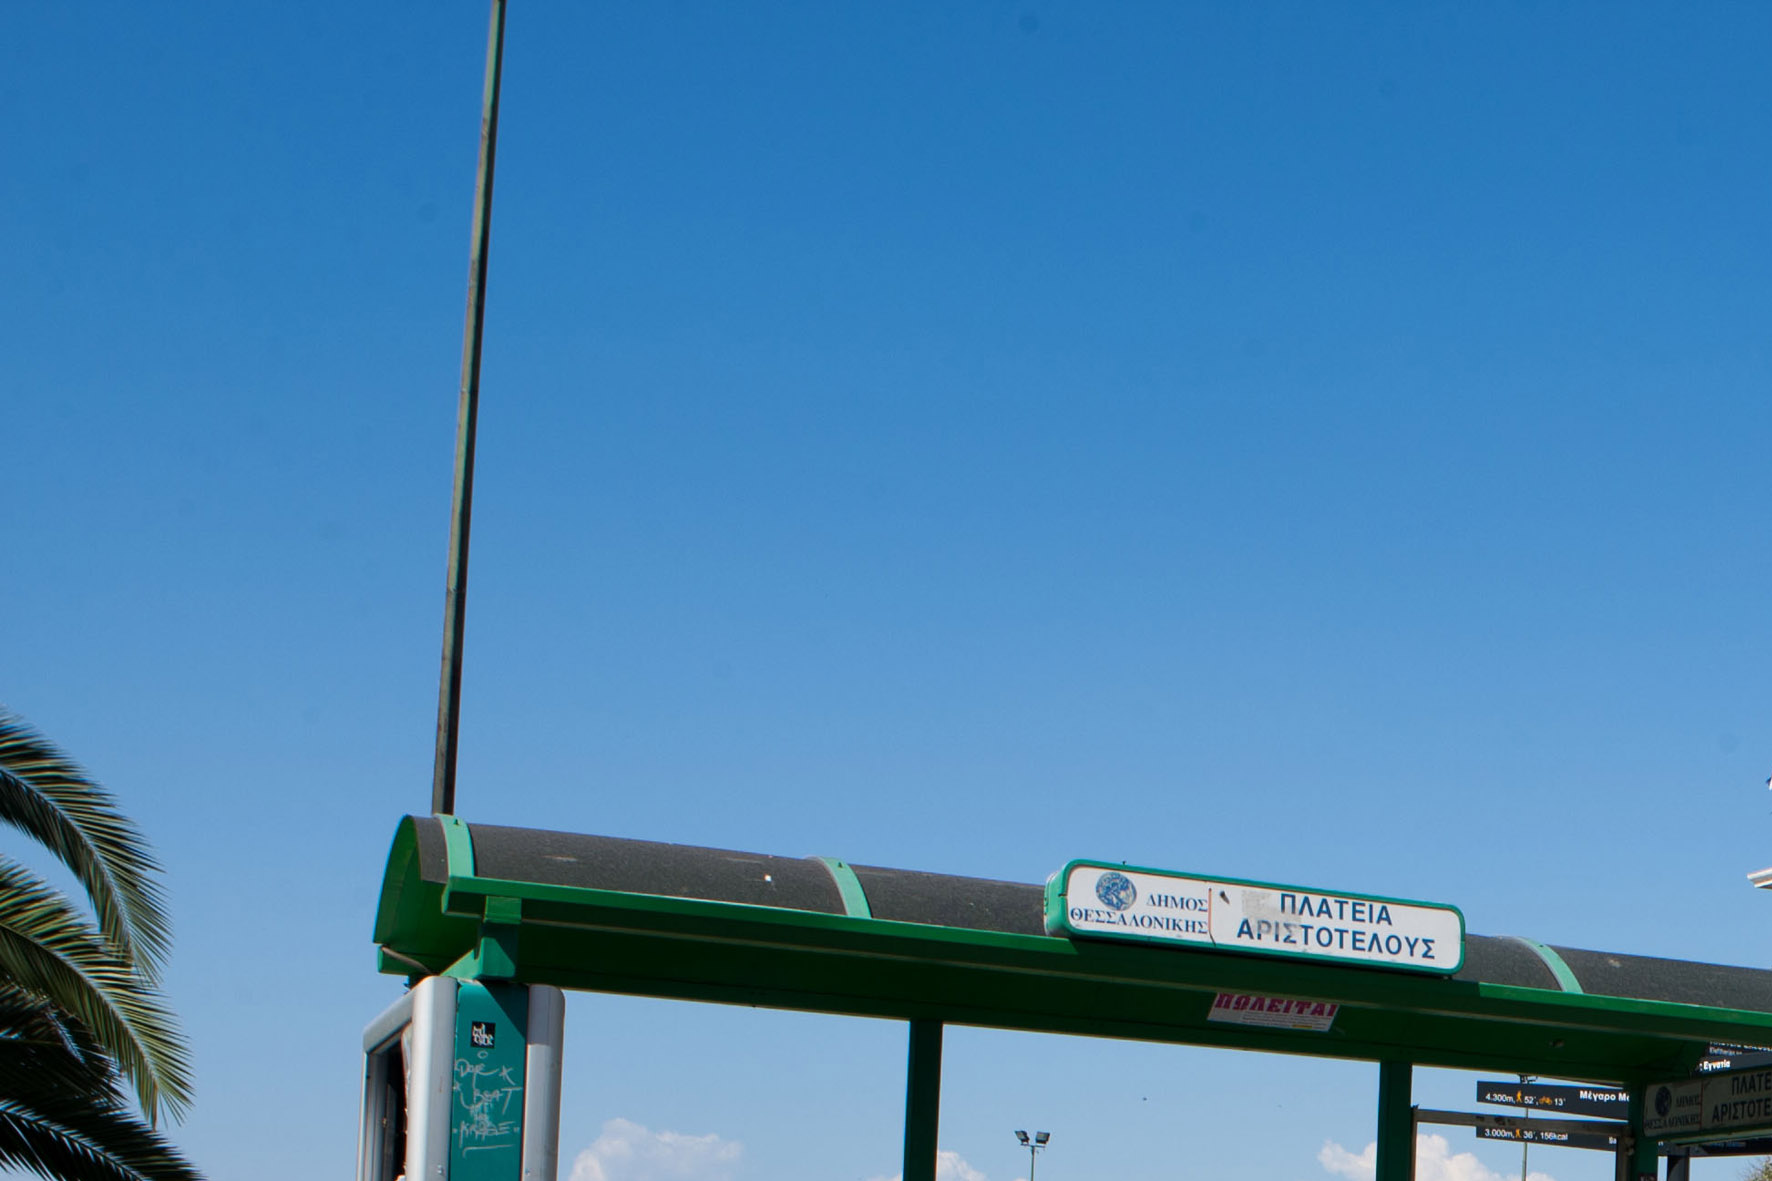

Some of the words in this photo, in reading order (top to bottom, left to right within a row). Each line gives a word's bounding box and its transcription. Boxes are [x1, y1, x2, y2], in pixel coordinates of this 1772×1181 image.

[1145, 893, 1208, 913] ΔΗΜΟΣ
[1280, 892, 1392, 926] ΠΛΑΤΕΙΑ
[1070, 905, 1208, 935] ΘΕΣΣΑΛΟΝΙΚΗΣ
[1236, 917, 1436, 960] ΑΡΙΣΤΟΤΕΛΟΥΣ
[1215, 992, 1339, 1017] ΠΩΛΕΙΤΑΙ
[1579, 1089, 1616, 1103] Μέγαρο
